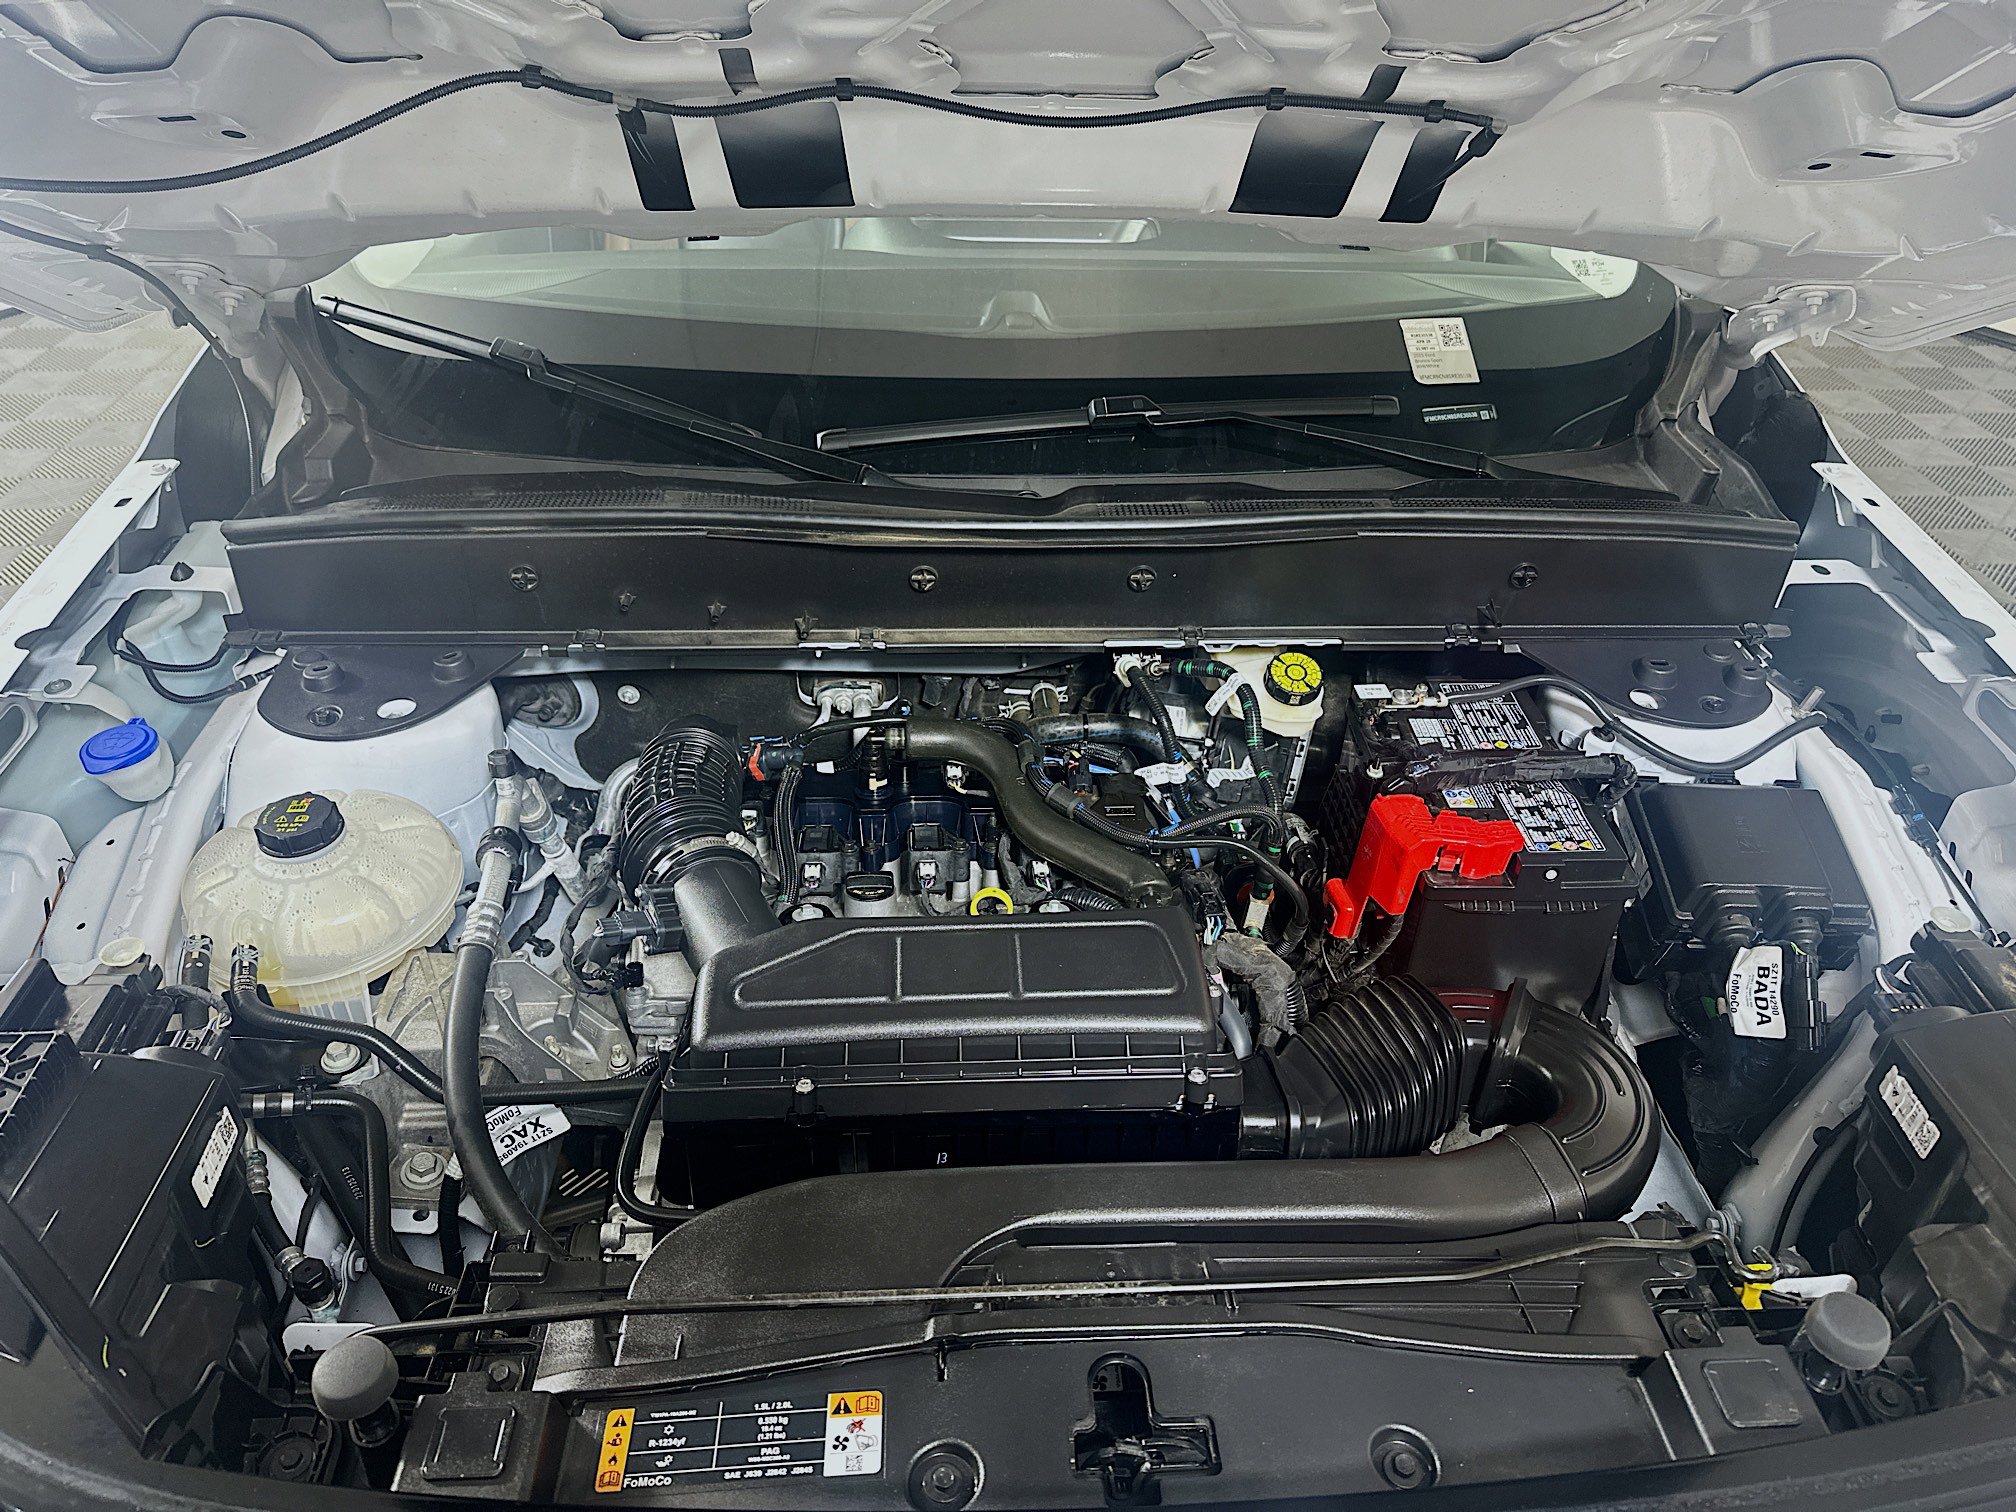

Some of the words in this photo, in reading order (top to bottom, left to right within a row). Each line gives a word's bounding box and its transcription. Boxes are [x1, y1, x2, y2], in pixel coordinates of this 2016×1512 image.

[1770, 963, 1779, 985] SZ1T
[1730, 973, 1742, 1014] FoMoCo
[1753, 966, 1772, 1026] BADA
[1769, 989, 1780, 1016] 14290
[499, 1115, 546, 1148] XAC
[531, 1127, 553, 1143] SZ1T
[936, 1152, 948, 1165] 13
[777, 1415, 789, 1425] kg
[648, 1435, 687, 1448] R-1234yf
[760, 1446, 780, 1456] PAG
[623, 1475, 672, 1488] FoMoCo
[723, 1471, 742, 1479] SAE
